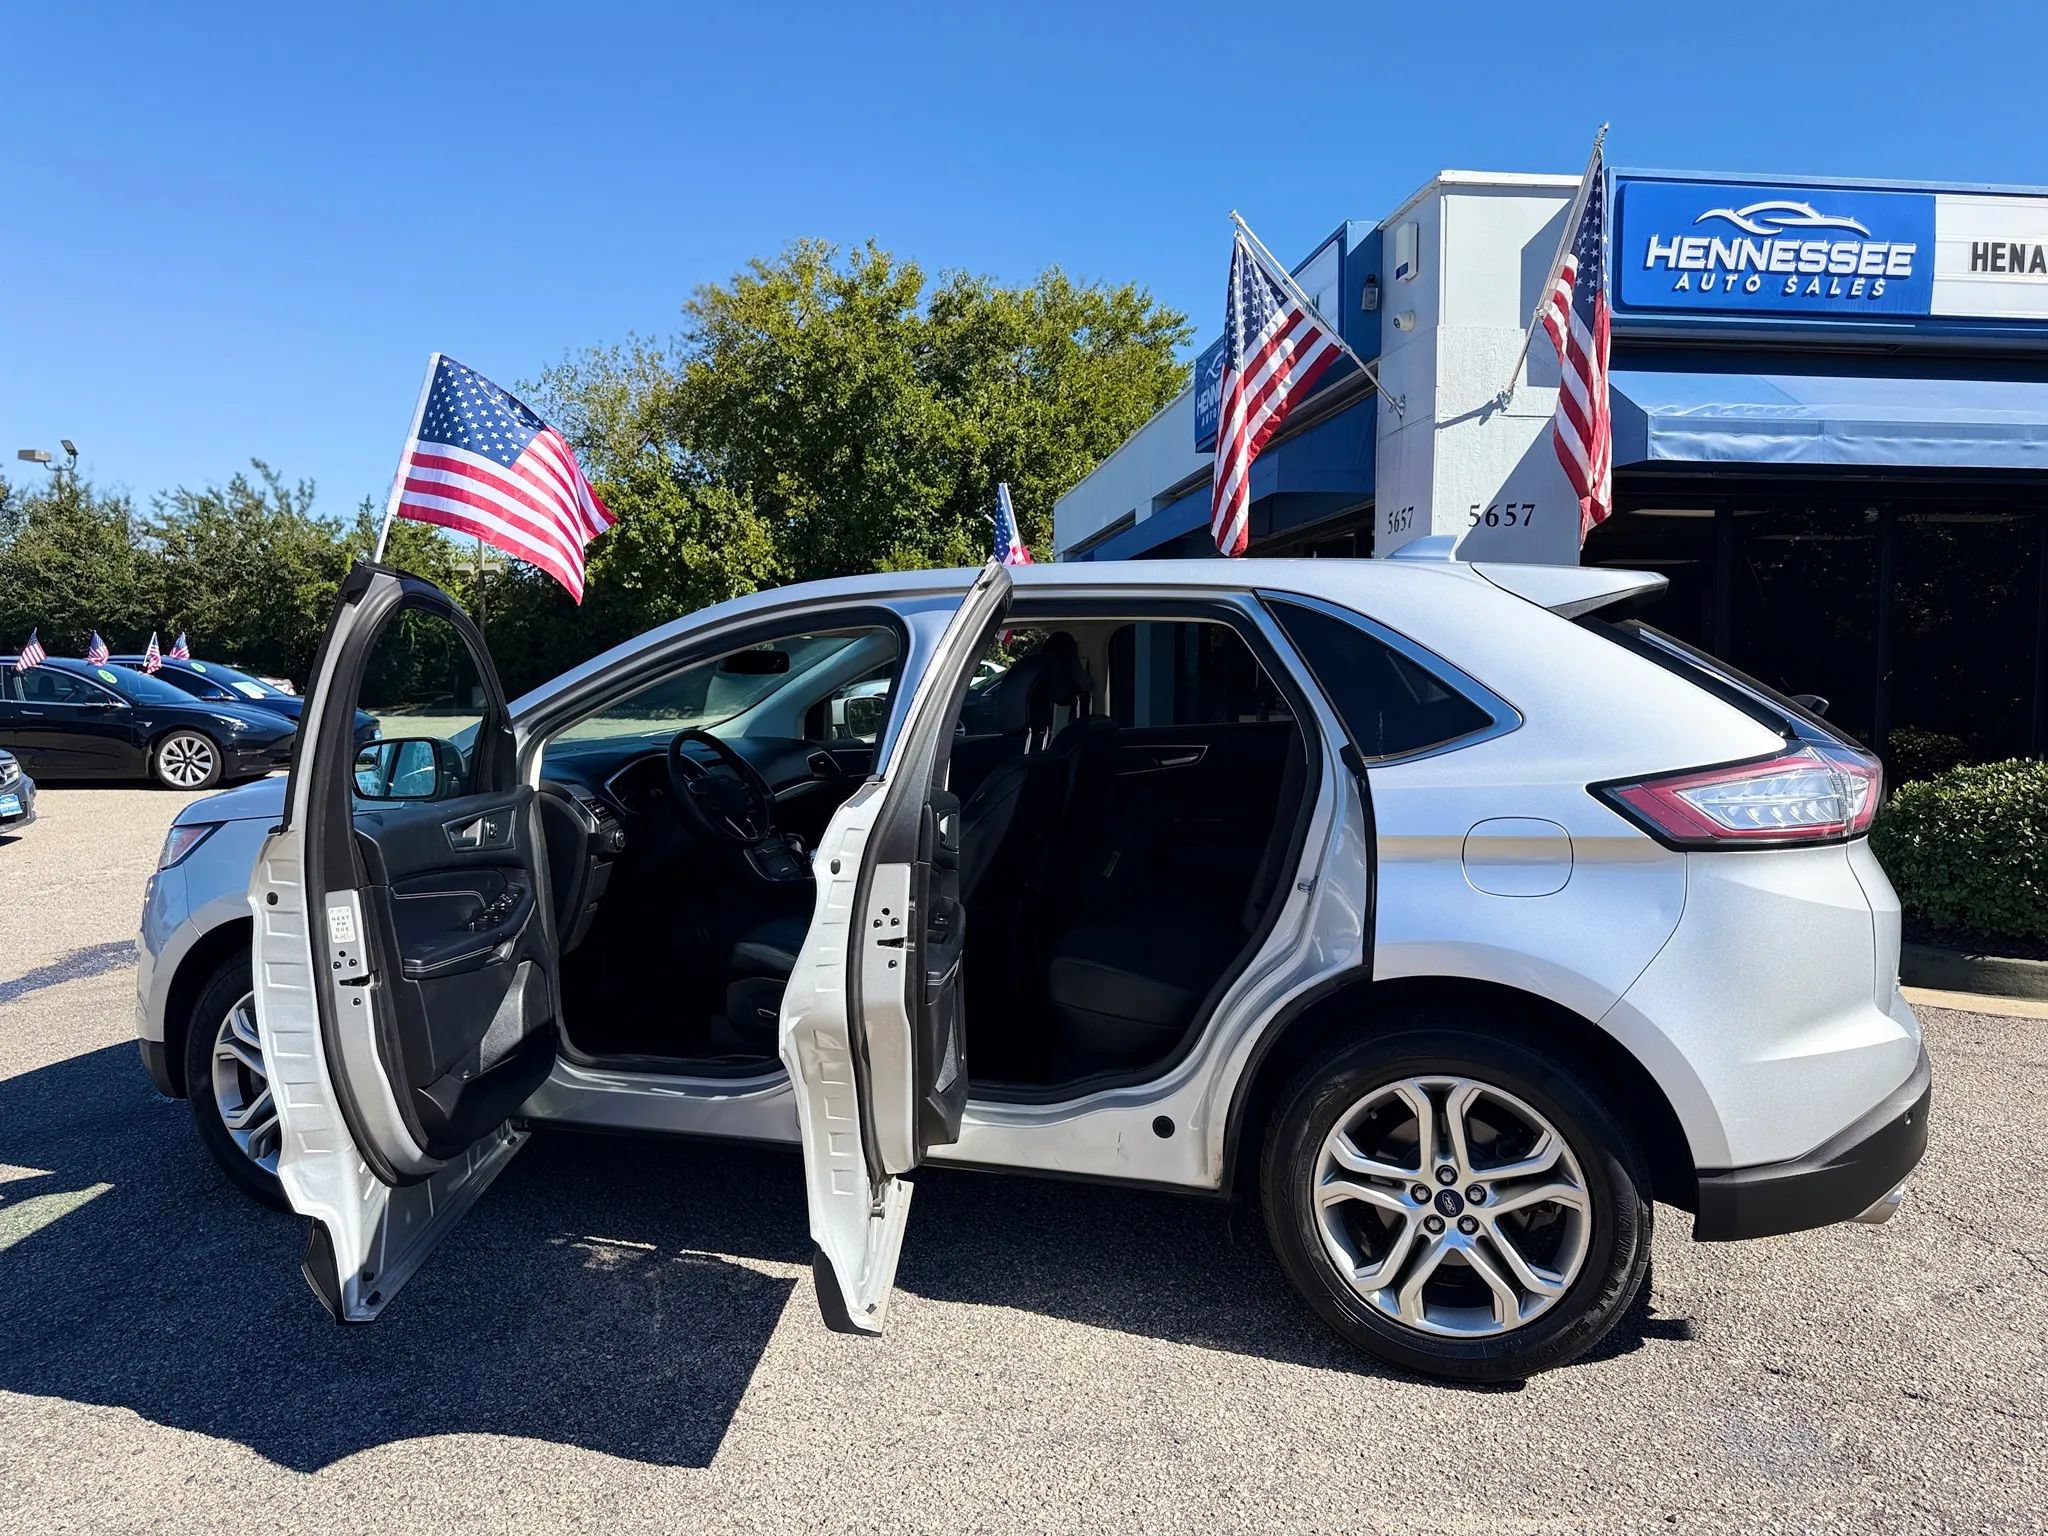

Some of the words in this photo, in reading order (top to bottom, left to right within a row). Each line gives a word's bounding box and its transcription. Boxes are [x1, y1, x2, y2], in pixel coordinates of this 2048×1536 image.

[1645, 234, 1917, 277] HENNESSEE
[1971, 241, 2047, 274] HENA
[1674, 271, 1762, 292] AUTO
[1784, 275, 1886, 297] SALES
[1387, 505, 1415, 535] 5657
[1468, 502, 1536, 528] 5657
